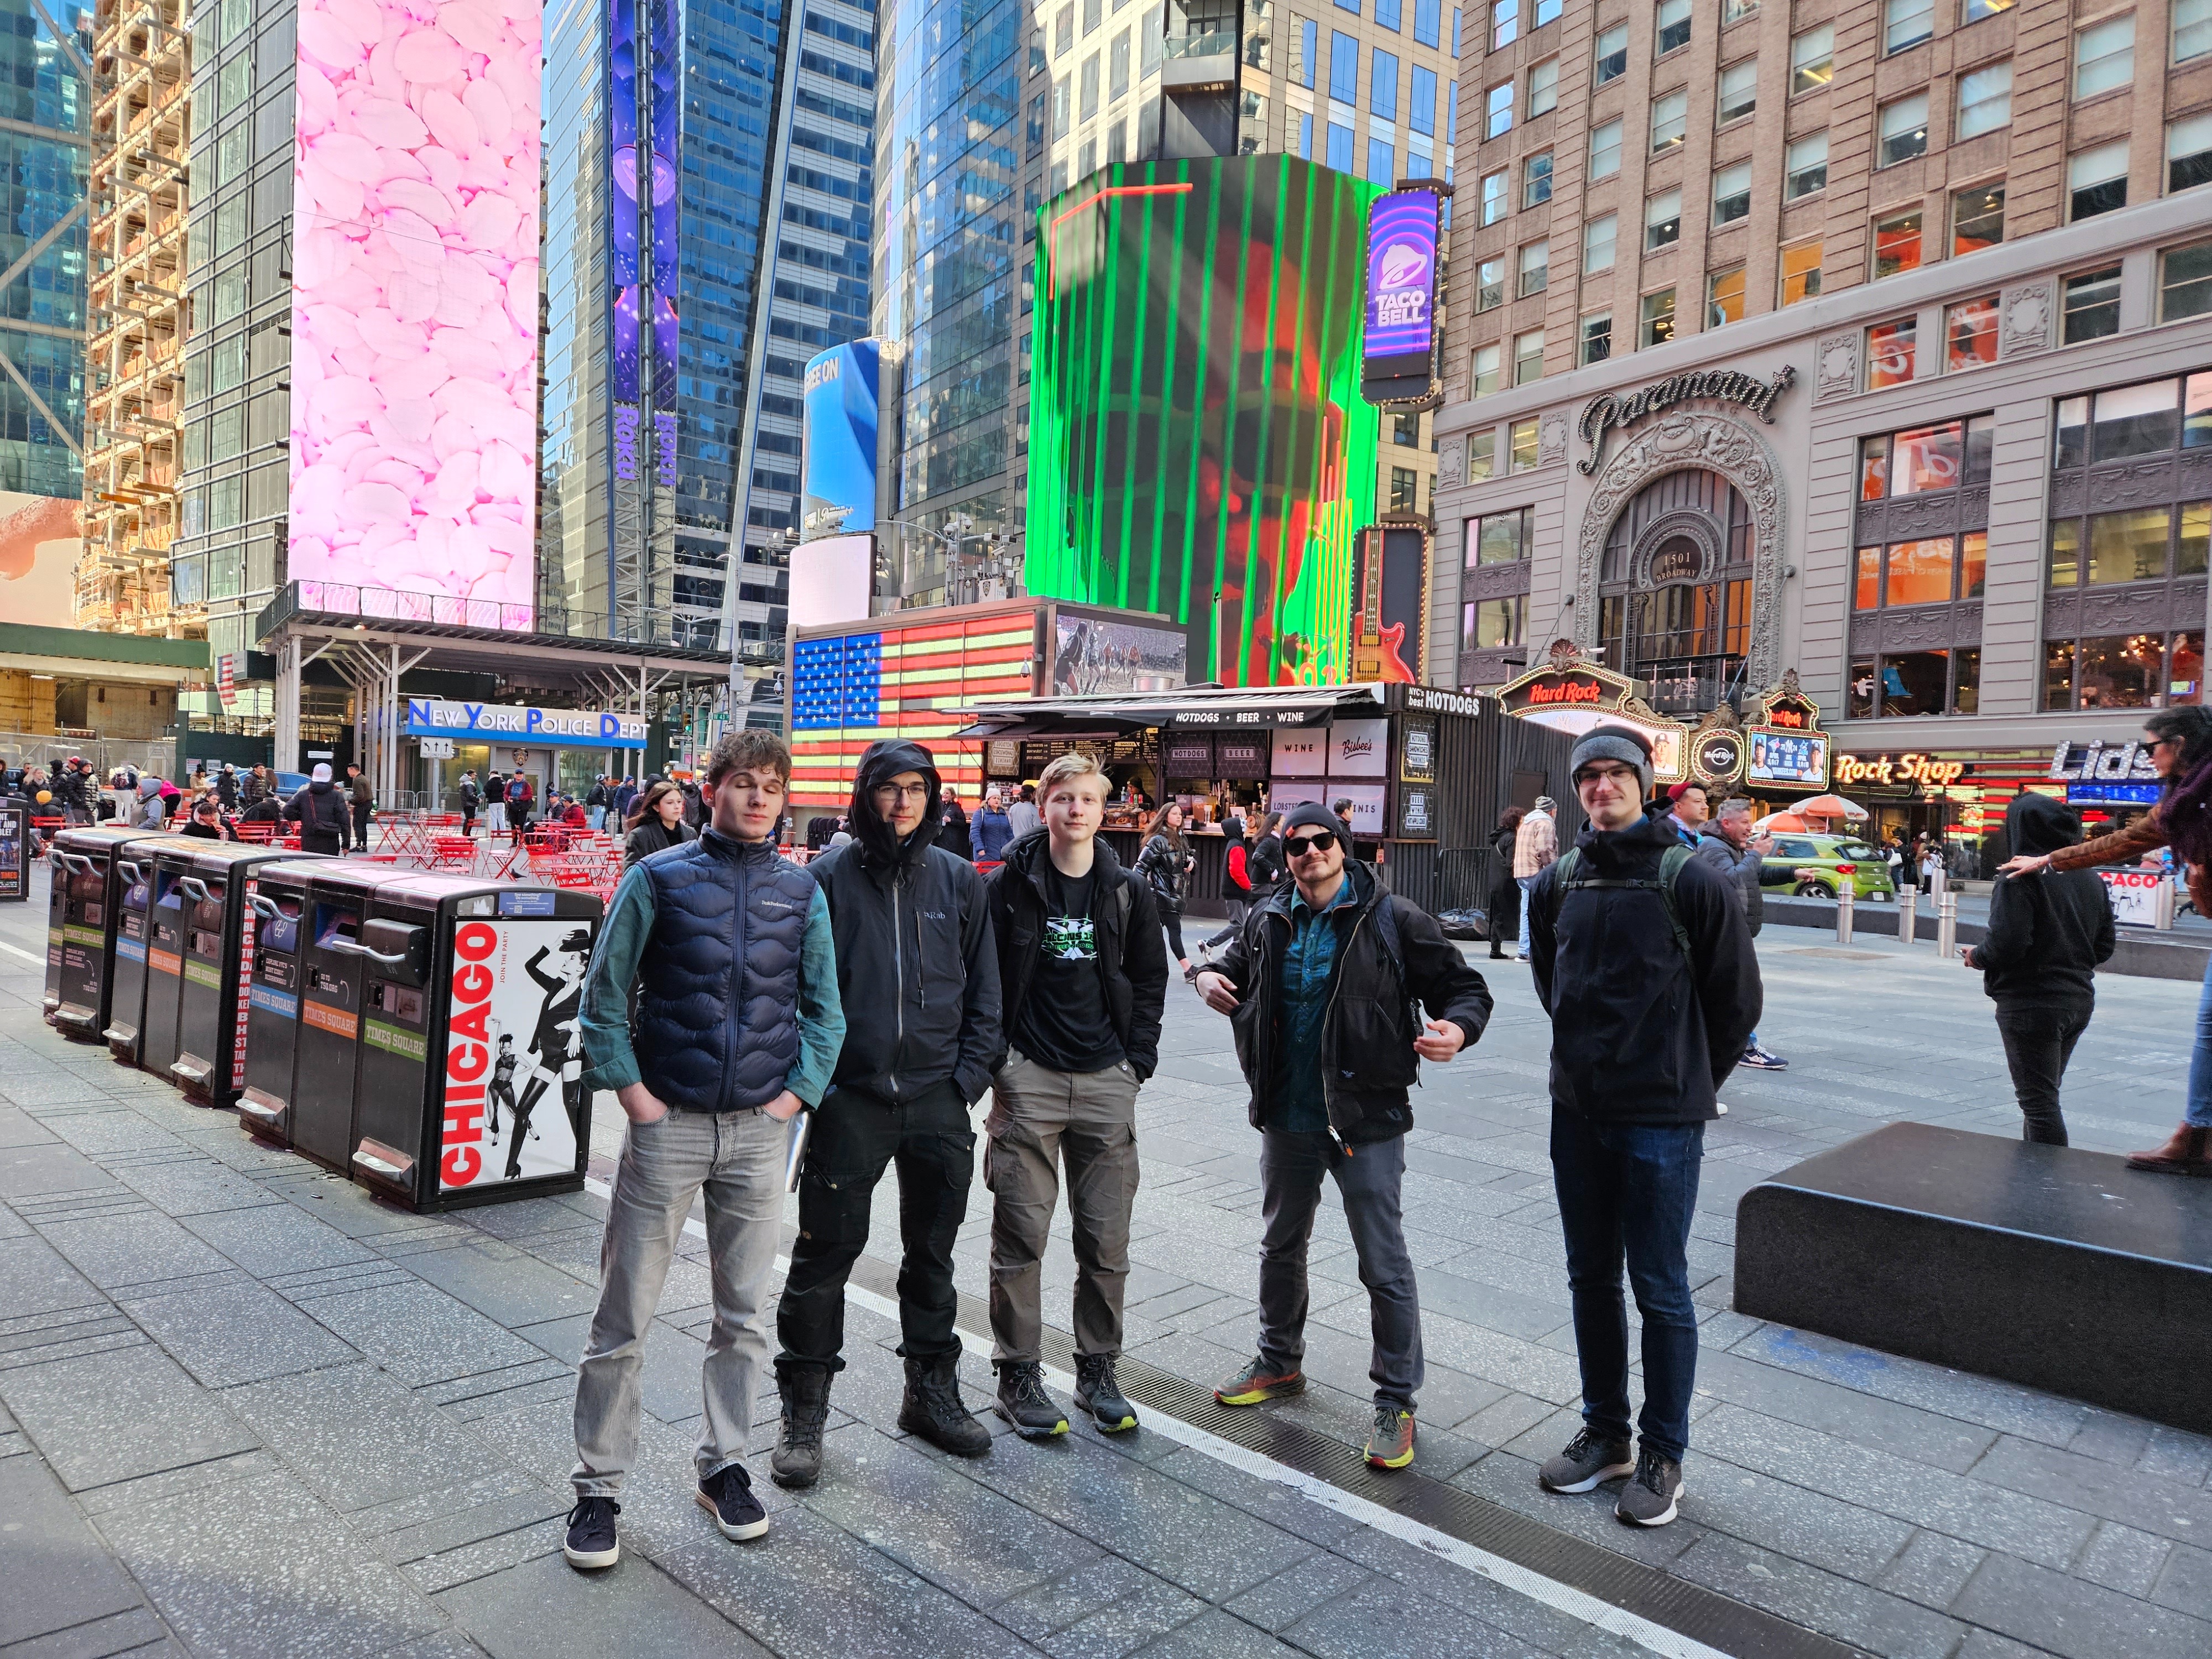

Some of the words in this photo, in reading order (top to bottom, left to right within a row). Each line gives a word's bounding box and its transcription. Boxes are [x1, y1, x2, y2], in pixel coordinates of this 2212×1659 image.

[1375, 290, 1426, 311] TACO
[1378, 306, 1425, 327] BELL
[822, 356, 838, 382] ON
[1577, 364, 1796, 476] Paramount
[1664, 552, 1689, 565] 1501
[1656, 568, 1697, 582] BROADWAY
[1409, 687, 1424, 697] NYC's
[1530, 683, 1566, 702] Hard
[1566, 681, 1600, 703] Rock
[1408, 696, 1423, 707] best
[1426, 690, 1480, 716] HOTDOGS
[409, 698, 461, 728] NEW
[464, 704, 520, 732] YORK
[526, 708, 592, 736] POLICE
[600, 713, 651, 739] DEPT
[1176, 712, 1219, 723] HOTDOGS
[1237, 712, 1259, 723] BEER
[1277, 712, 1305, 722] WINE
[1783, 710, 1802, 728] Rock
[1228, 749, 1252, 757] BEER
[1285, 744, 1313, 753] WINE
[1342, 735, 1373, 755] Bisbee's
[1720, 752, 1735, 760] Rock
[2048, 739, 2159, 779] Lids
[1835, 754, 1893, 785] Rock
[1896, 753, 1963, 785] Shop
[1412, 796, 1423, 804] BEER
[65, 928, 82, 940] TIMES
[82, 931, 103, 945] SQUARE
[117, 941, 129, 953] TIMES
[130, 945, 145, 959] SQUARE
[149, 952, 163, 965] TIMES
[163, 956, 180, 972] SQUARE
[186, 964, 201, 979] TIMES
[201, 967, 220, 987] SQUARE
[321, 981, 338, 993] TSQ.ORG
[251, 989, 270, 1006] TIMES
[271, 994, 295, 1013] SQUARE
[305, 1005, 325, 1024] TIMES
[326, 1012, 355, 1034] SQUARE
[367, 1025, 391, 1045] TIMES
[392, 1034, 424, 1056] SQUARE
[440, 922, 498, 1187] CHICAGO
